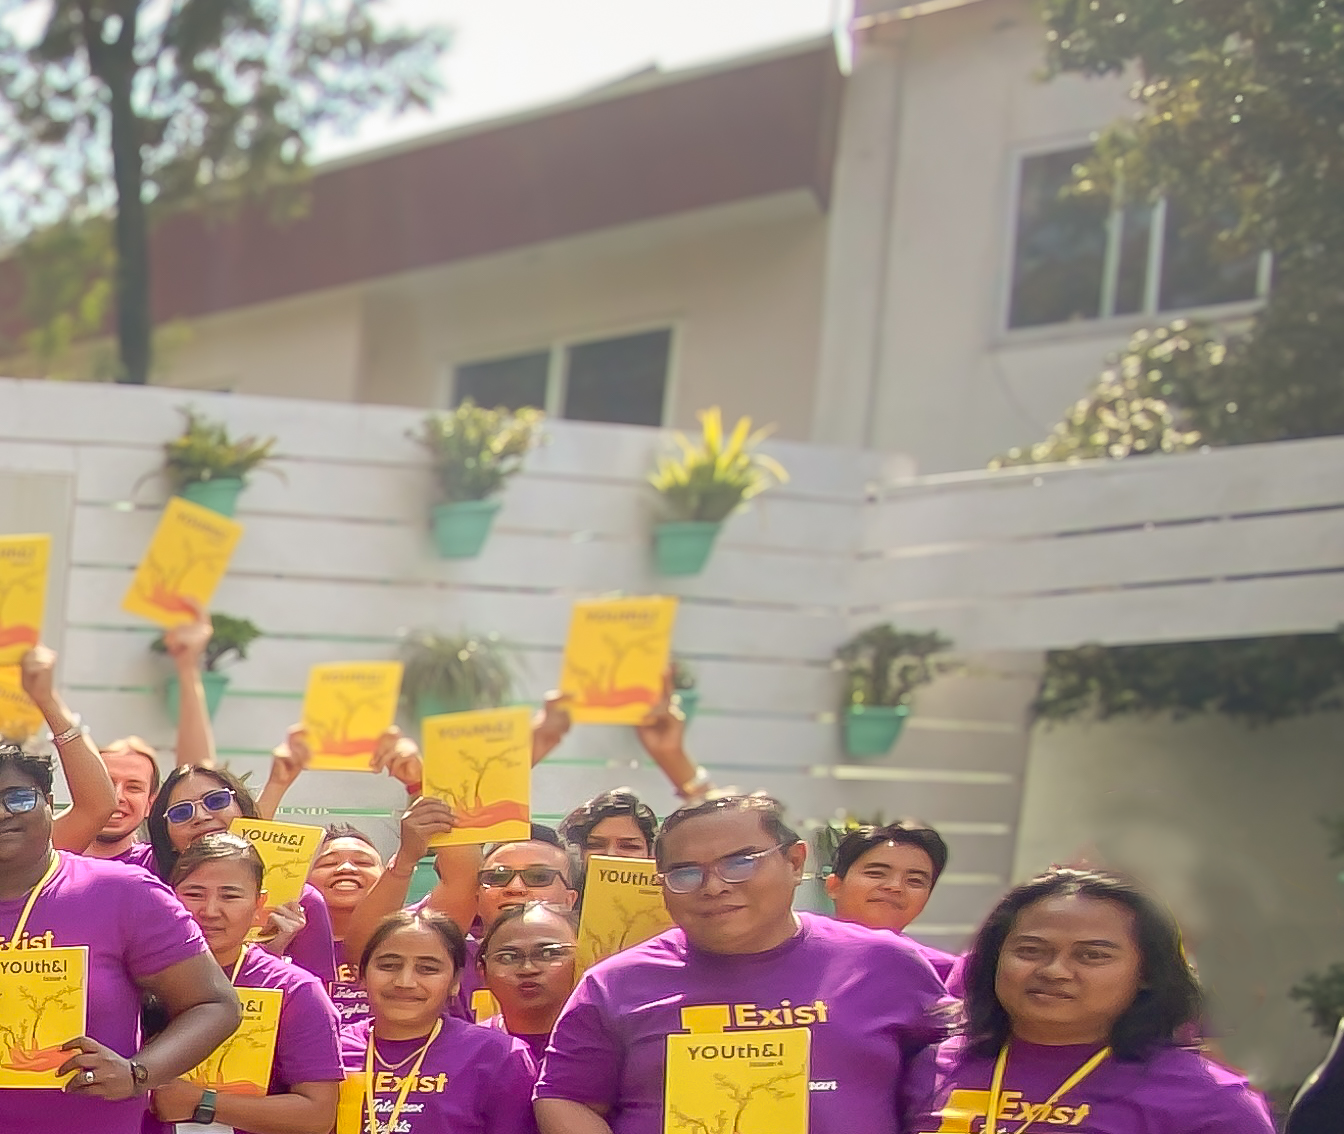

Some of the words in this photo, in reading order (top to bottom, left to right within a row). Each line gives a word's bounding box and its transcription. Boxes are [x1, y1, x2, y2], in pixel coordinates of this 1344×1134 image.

[241, 829, 306, 846] YOUth&I
[0, 960, 67, 974] YOUth&I
[736, 999, 830, 1028] Exist
[687, 1043, 784, 1061] YOUth&I
